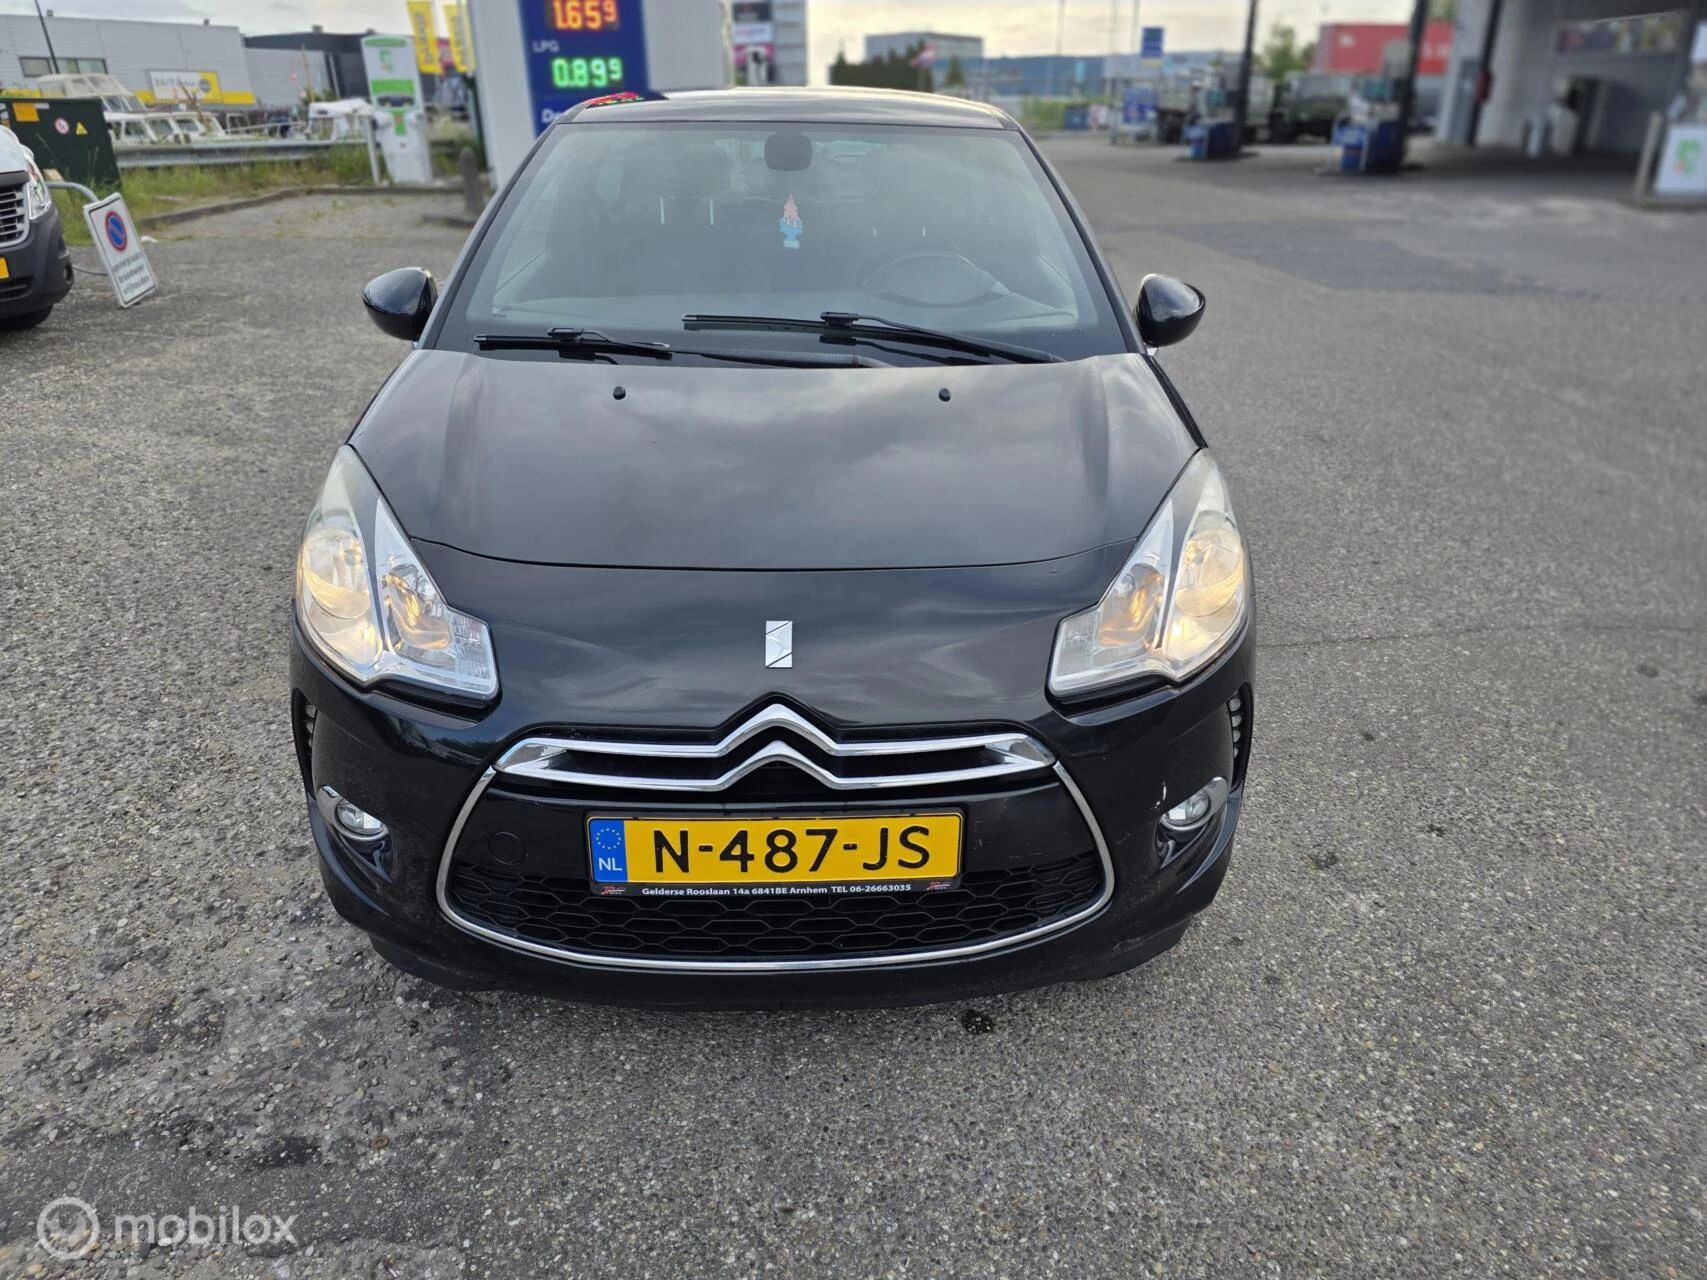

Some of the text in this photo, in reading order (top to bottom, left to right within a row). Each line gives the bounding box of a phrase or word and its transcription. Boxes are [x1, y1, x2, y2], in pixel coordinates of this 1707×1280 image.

[653, 825, 930, 873] N-487-JS
[598, 857, 622, 871] NL
[641, 883, 911, 896] Gelderse Rooslaan 14a 6841BE Arnhem TEL 06-26663035
